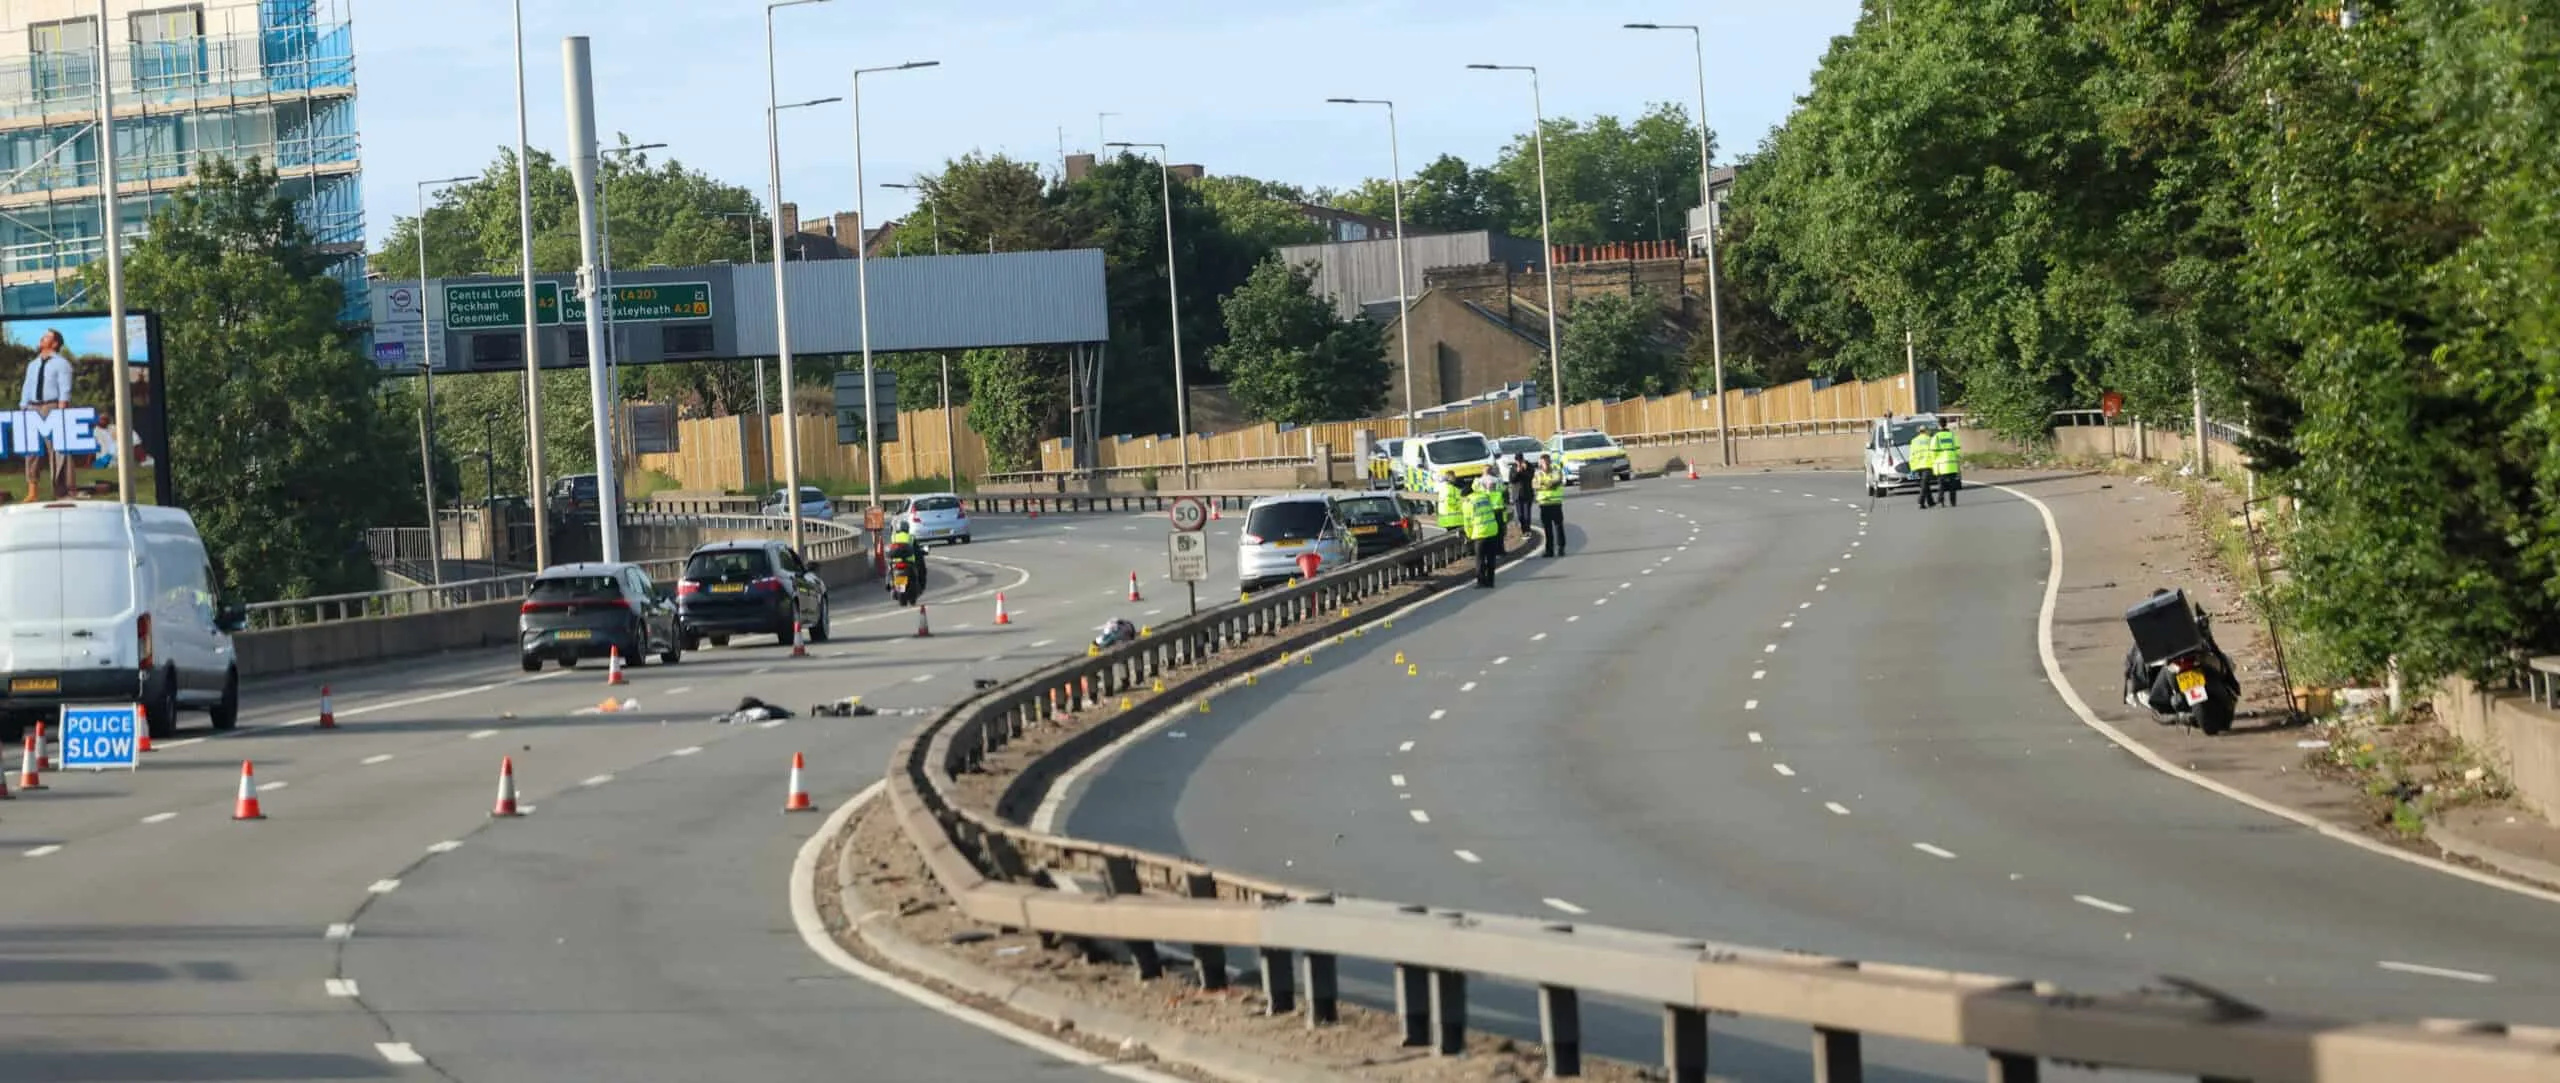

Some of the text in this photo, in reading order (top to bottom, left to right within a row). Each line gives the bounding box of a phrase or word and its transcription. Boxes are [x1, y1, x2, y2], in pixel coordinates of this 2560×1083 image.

[450, 287, 526, 301] Central Londo
[450, 301, 499, 312] Peckham
[539, 297, 554, 308] A2
[451, 312, 509, 324] Greenwich
[1175, 506, 1199, 521] 50
[68, 715, 132, 733] POLICE
[68, 736, 131, 758] SLOW
